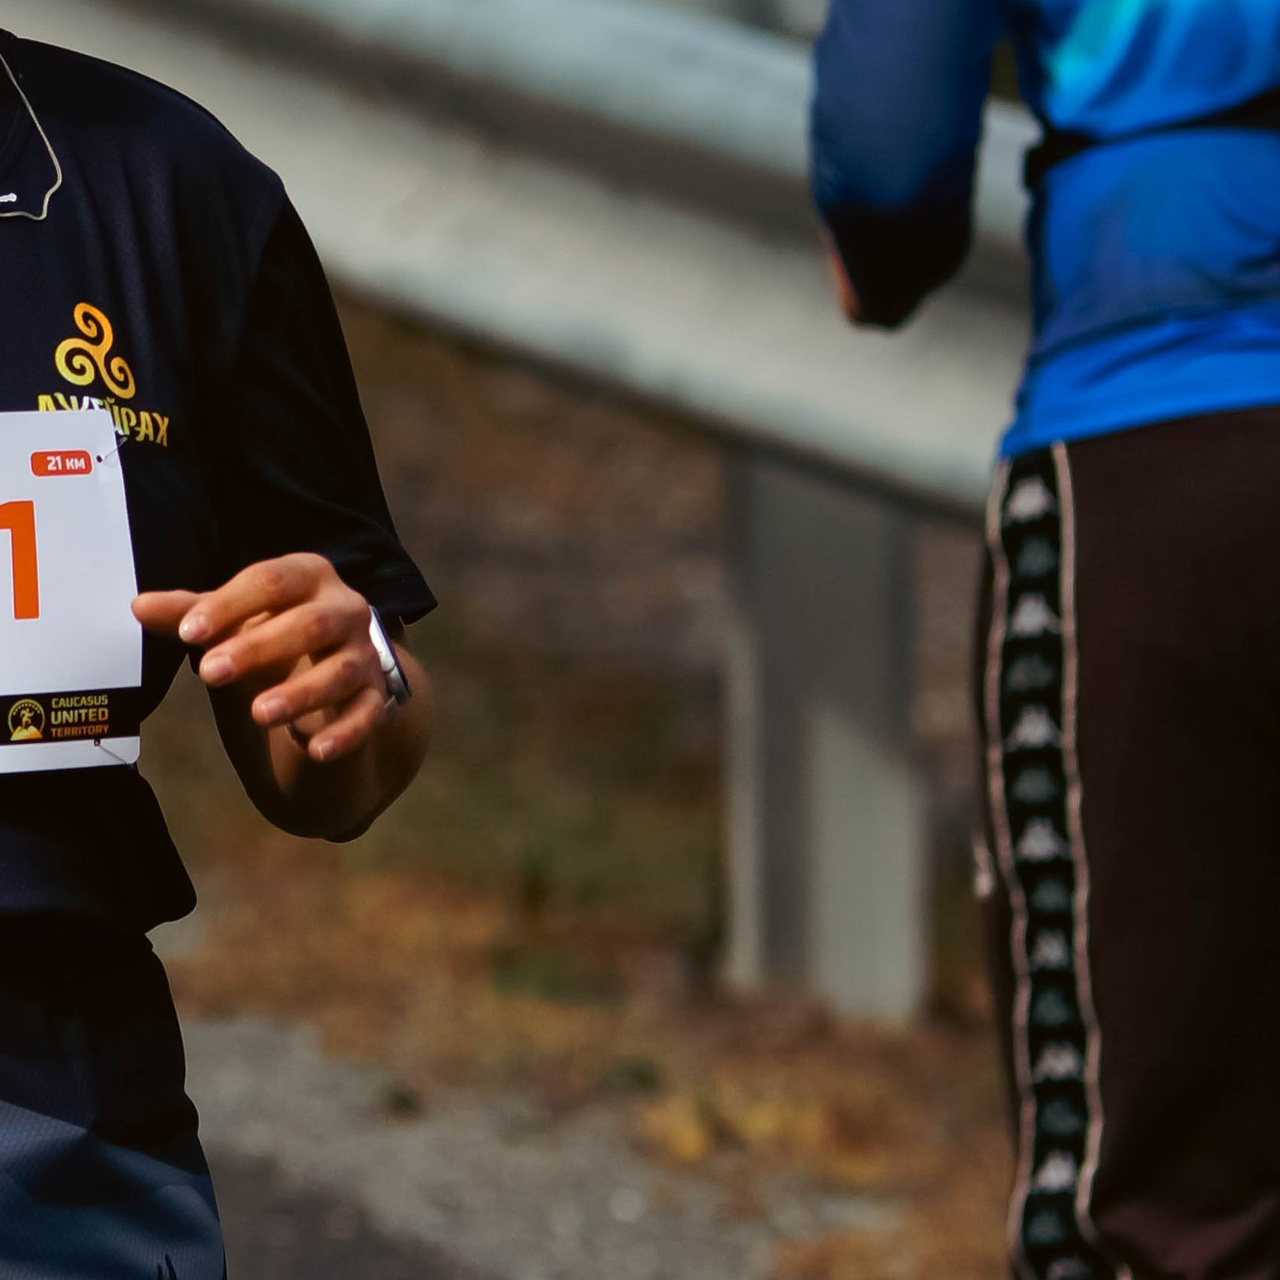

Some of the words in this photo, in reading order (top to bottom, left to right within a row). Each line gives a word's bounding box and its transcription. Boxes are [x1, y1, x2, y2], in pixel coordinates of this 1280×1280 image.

[46, 455, 62, 470] 21
[51, 694, 109, 708] CAUCASUS
[51, 708, 109, 725] UNITED
[51, 724, 109, 738] TERRITORY
